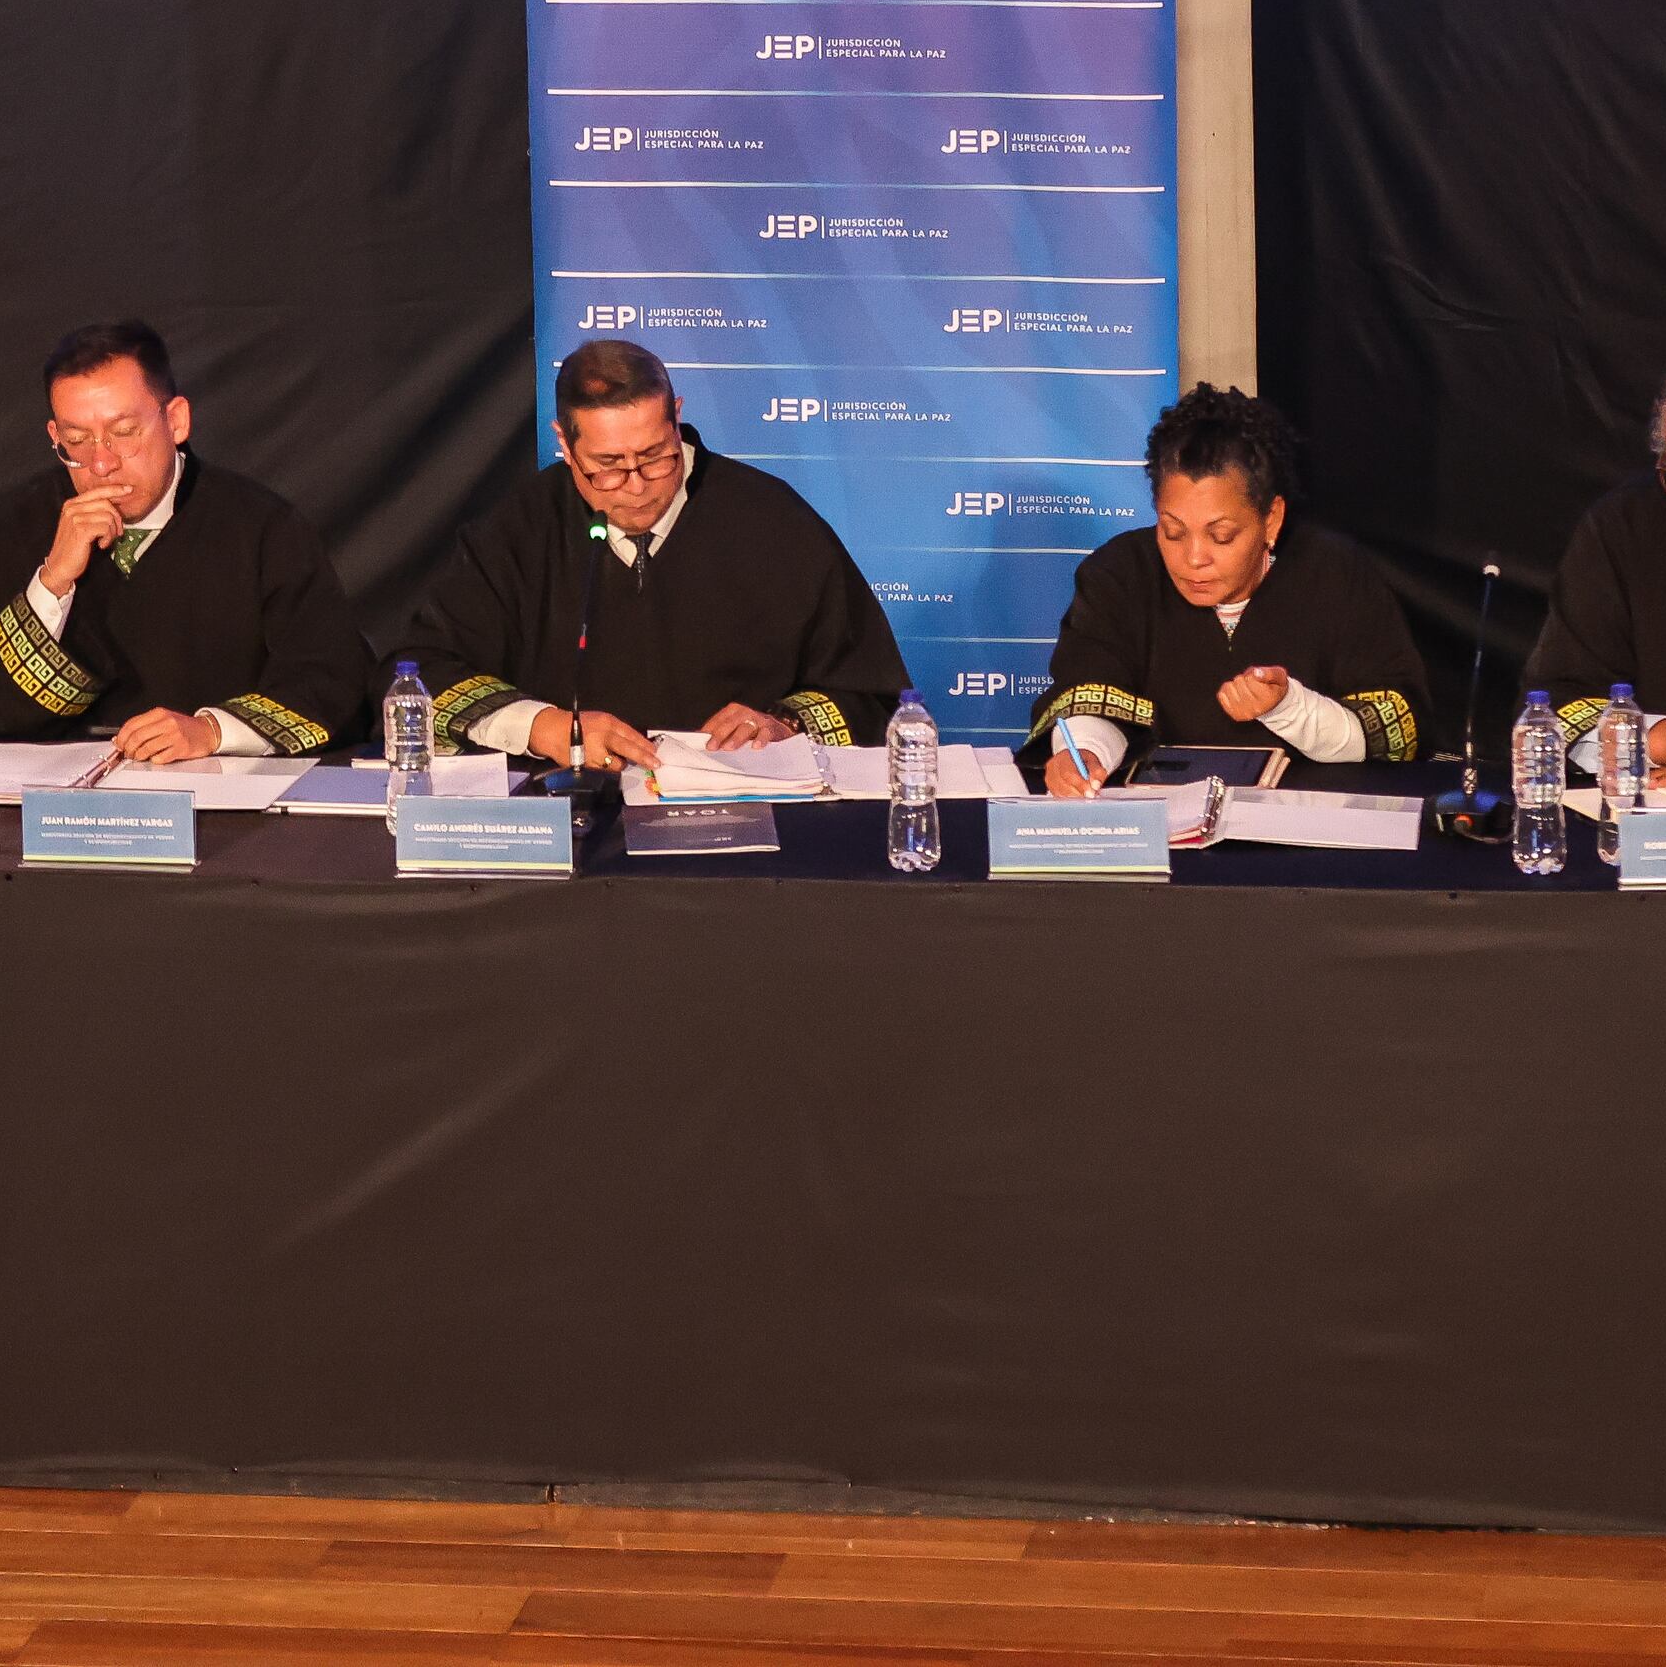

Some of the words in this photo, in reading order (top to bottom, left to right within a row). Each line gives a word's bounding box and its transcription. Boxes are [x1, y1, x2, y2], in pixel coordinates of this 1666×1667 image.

[755, 35, 815, 60] JEP
[825, 37, 901, 48] JURISDICCIÓN
[826, 48, 876, 58] ESPECIAL
[879, 49, 906, 58] PARA
[909, 50, 923, 58] LA
[926, 49, 946, 59] PAZ
[574, 127, 633, 151] JEP
[644, 127, 719, 139] JURISDICCIÓN
[1011, 132, 1086, 144] JURISDICCIÓN
[644, 139, 694, 149] ESPECIAL
[697, 139, 724, 149] PARA
[728, 140, 741, 149] LA
[744, 140, 764, 149] PAZ
[940, 129, 1000, 154] JEP
[1011, 143, 1060, 153] ESPECIAL
[1064, 145, 1091, 154] PARA
[1094, 145, 1108, 154] LA
[1111, 145, 1131, 155] PAZ
[758, 214, 818, 239] JEP
[828, 216, 904, 228] JURISDICCIÓN
[828, 228, 878, 238] ESPECIAL
[881, 228, 909, 238] PARA
[912, 229, 926, 238] LA
[929, 229, 949, 239] PAZ
[578, 305, 637, 330] JEP
[647, 306, 722, 318] JURISDICCIÓN
[1013, 311, 1088, 323] JURISDICCIÓN
[648, 318, 698, 327] ESPECIAL
[700, 318, 728, 328] PARA
[731, 319, 744, 328] LA
[747, 319, 767, 328] PAZ
[943, 309, 1003, 333] JEP
[1014, 322, 1063, 332] ESPECIAL
[1066, 324, 1094, 333] PARA
[1096, 325, 1111, 334] LA
[1113, 325, 1133, 334] PAZ
[761, 397, 821, 422] JEP
[831, 400, 907, 411] JURISDICCIÓN
[831, 412, 880, 421] ESPECIAL
[884, 412, 912, 421] PARA
[915, 413, 928, 421] LA
[931, 413, 951, 422] PAZ
[945, 492, 1005, 516] JEP
[1016, 494, 1090, 505] JURISDICCIÓN
[1016, 505, 1065, 514] ESPECIAL
[1069, 506, 1096, 515] PARA
[1099, 507, 1112, 517] LA
[1115, 508, 1135, 517] PAZ
[870, 580, 909, 592] ICCIÓN
[887, 593, 914, 602] PARA
[917, 594, 931, 602] LA
[934, 594, 954, 603] PAZ
[948, 672, 1007, 696] JEP
[1018, 676, 1055, 685] JURISD
[41, 816, 63, 826] JUAN
[64, 816, 96, 826] RAMÓN
[97, 816, 139, 827] MARTÍNEZ
[140, 818, 174, 828] VARGAS
[413, 823, 447, 833] CAMILO
[449, 823, 483, 834] ANDRÉS
